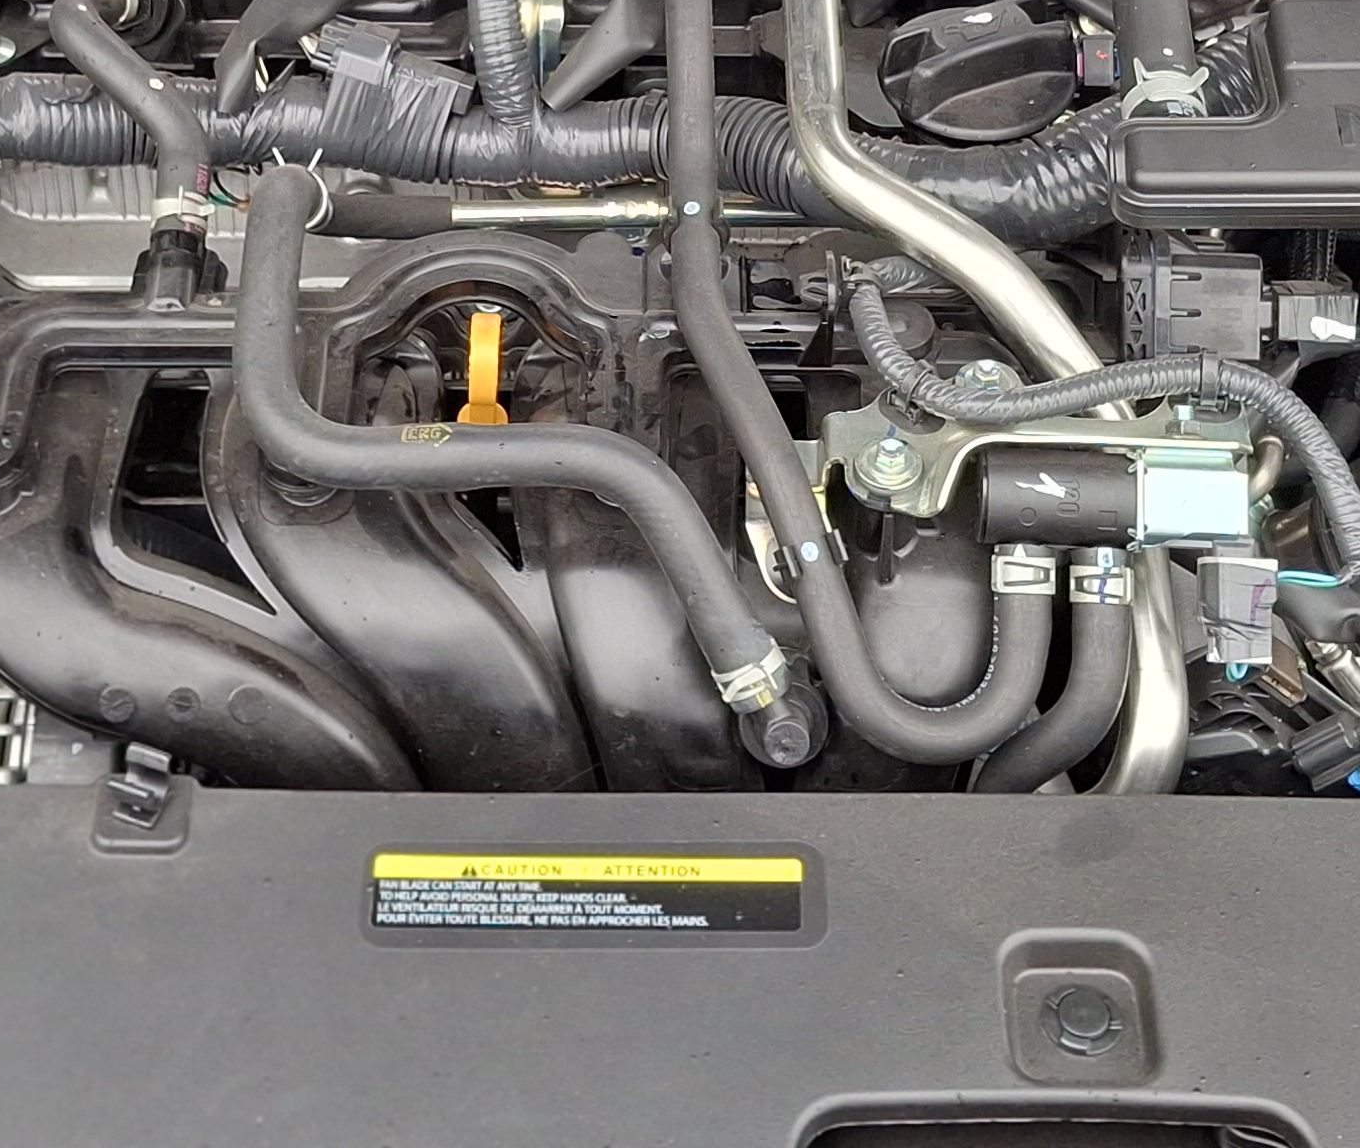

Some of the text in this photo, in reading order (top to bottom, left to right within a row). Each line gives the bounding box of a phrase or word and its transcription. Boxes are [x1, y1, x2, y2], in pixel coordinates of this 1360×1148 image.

[406, 427, 443, 441] ENG
[481, 864, 563, 876] CAUTION
[603, 865, 702, 877] ATTENTION
[379, 880, 399, 890] FAN
[401, 881, 430, 891] BLADE
[431, 880, 452, 891] CAN
[453, 881, 483, 892] START
[483, 881, 497, 892] AT
[497, 881, 517, 892] ANY
[379, 891, 393, 901] TO
[394, 891, 419, 902] HELP
[419, 891, 451, 902] AVOID
[451, 892, 500, 903] PERSONAL
[536, 893, 560, 903] KEEP
[561, 893, 595, 904] HANDS
[595, 893, 629, 904] CLEAR.
[377, 902, 391, 912] LE
[391, 902, 459, 914] VENTILATEUR
[461, 903, 499, 915] RISQUE
[500, 904, 515, 914] DE
[584, 905, 612, 915] TOUT
[613, 905, 664, 916] MOMENT.
[377, 914, 407, 924] POUR
[445, 914, 478, 925] TOUTE
[534, 915, 550, 926] NE
[551, 915, 571, 926] PAS
[572, 915, 587, 926] EN
[588, 916, 650, 927] APPROCHER
[651, 916, 671, 927] LES
[672, 916, 710, 927] MAINS.
